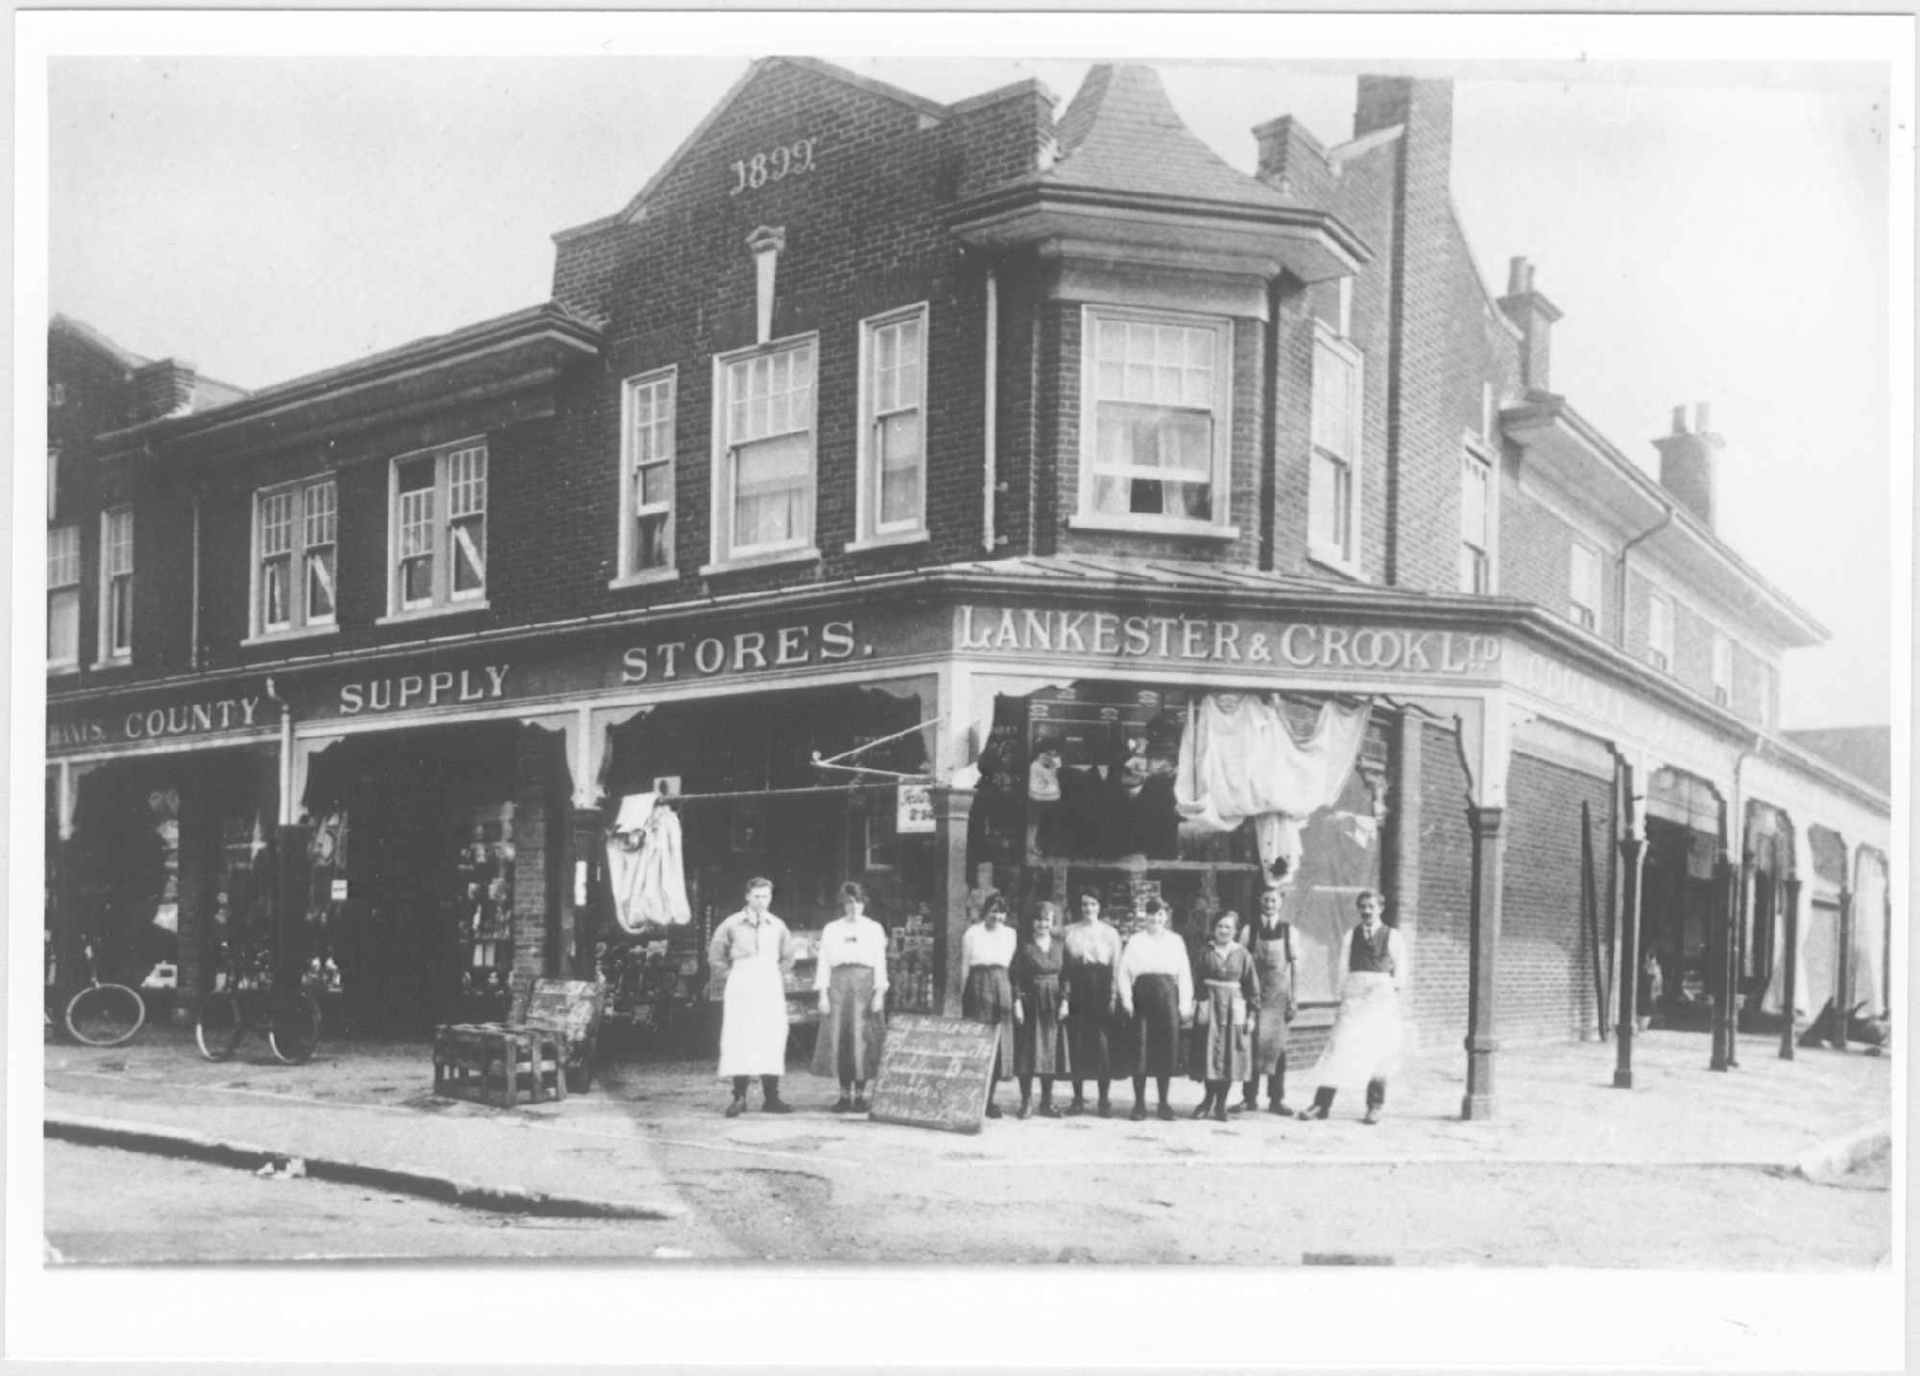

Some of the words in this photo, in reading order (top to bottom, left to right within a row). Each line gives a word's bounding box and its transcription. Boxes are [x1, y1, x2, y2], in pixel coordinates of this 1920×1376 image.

[125, 696, 259, 738] COUNTY
[339, 664, 510, 714] SUPPLY
[621, 620, 873, 682] STORES.
[959, 604, 1241, 659] LANKESTER
[1250, 632, 1272, 662] &
[1281, 623, 1432, 671] CROOK
